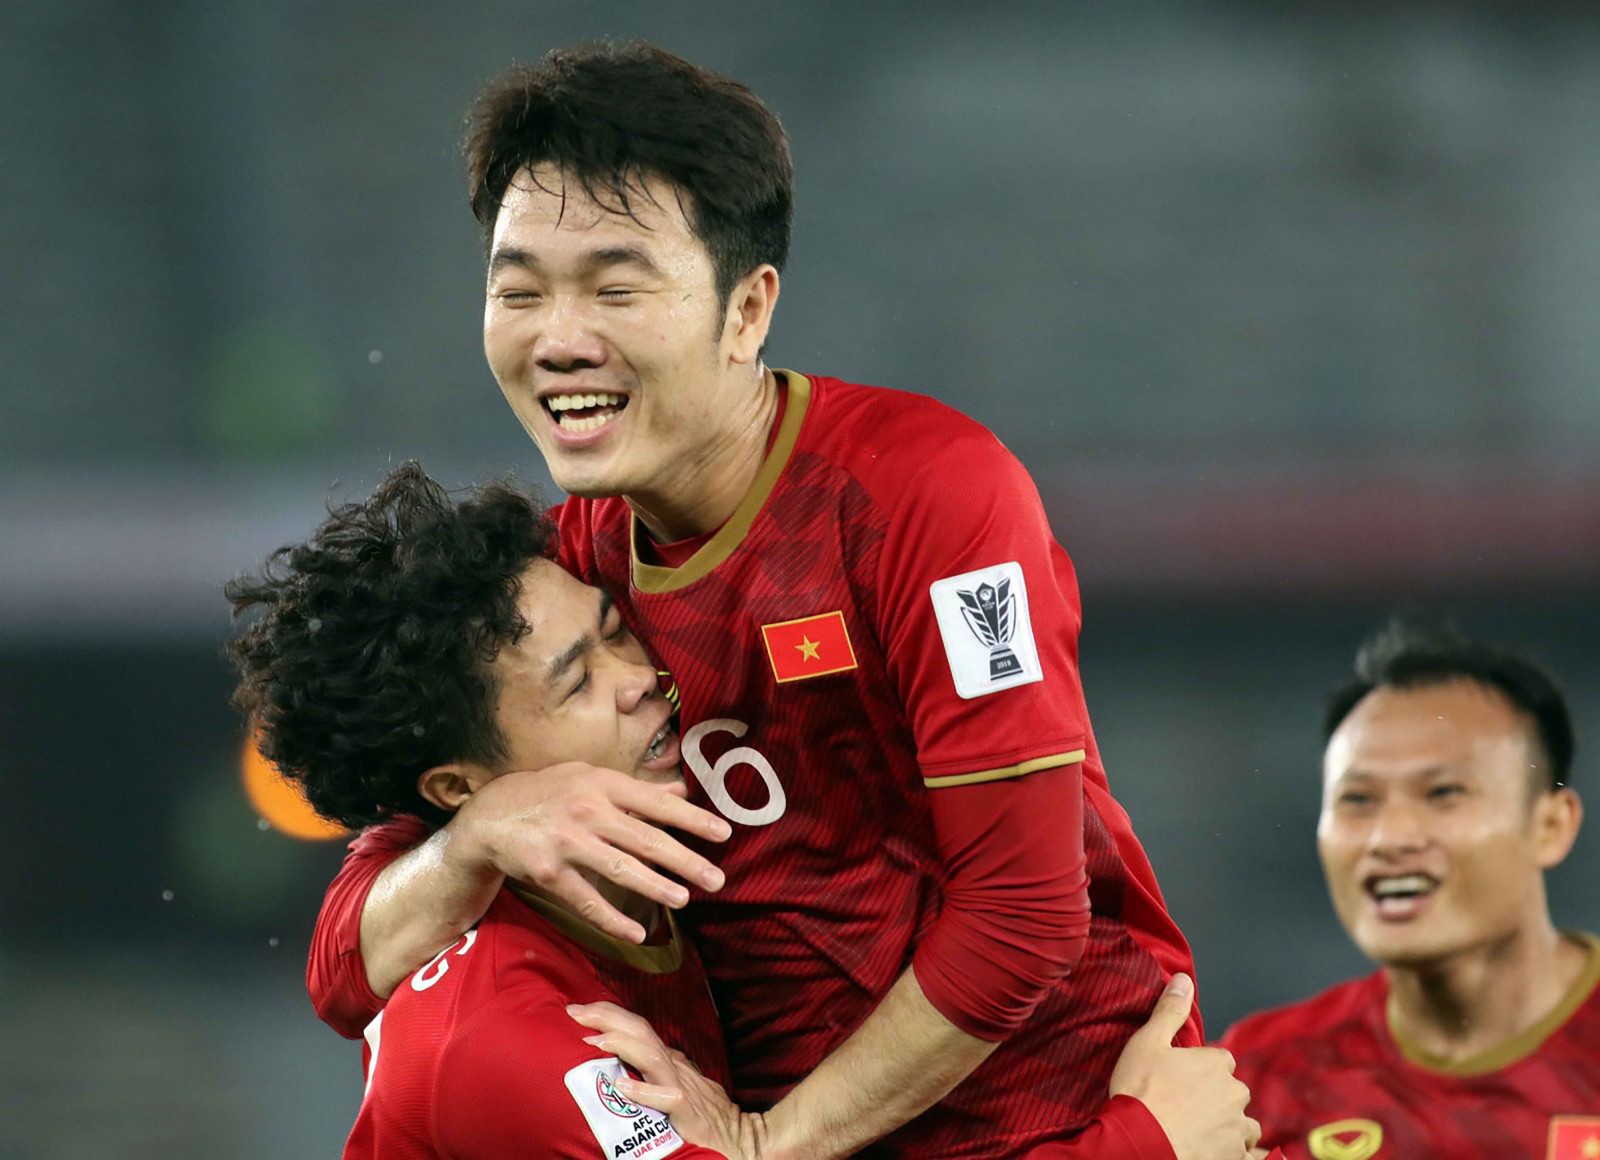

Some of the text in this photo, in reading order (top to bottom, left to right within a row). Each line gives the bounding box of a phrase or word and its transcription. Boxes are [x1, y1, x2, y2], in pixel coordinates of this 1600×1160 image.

[681, 718, 787, 826] 6
[633, 1115, 653, 1132] AFC
[615, 1127, 656, 1158] ASIAN
[633, 1131, 672, 1158] UAE 2019
